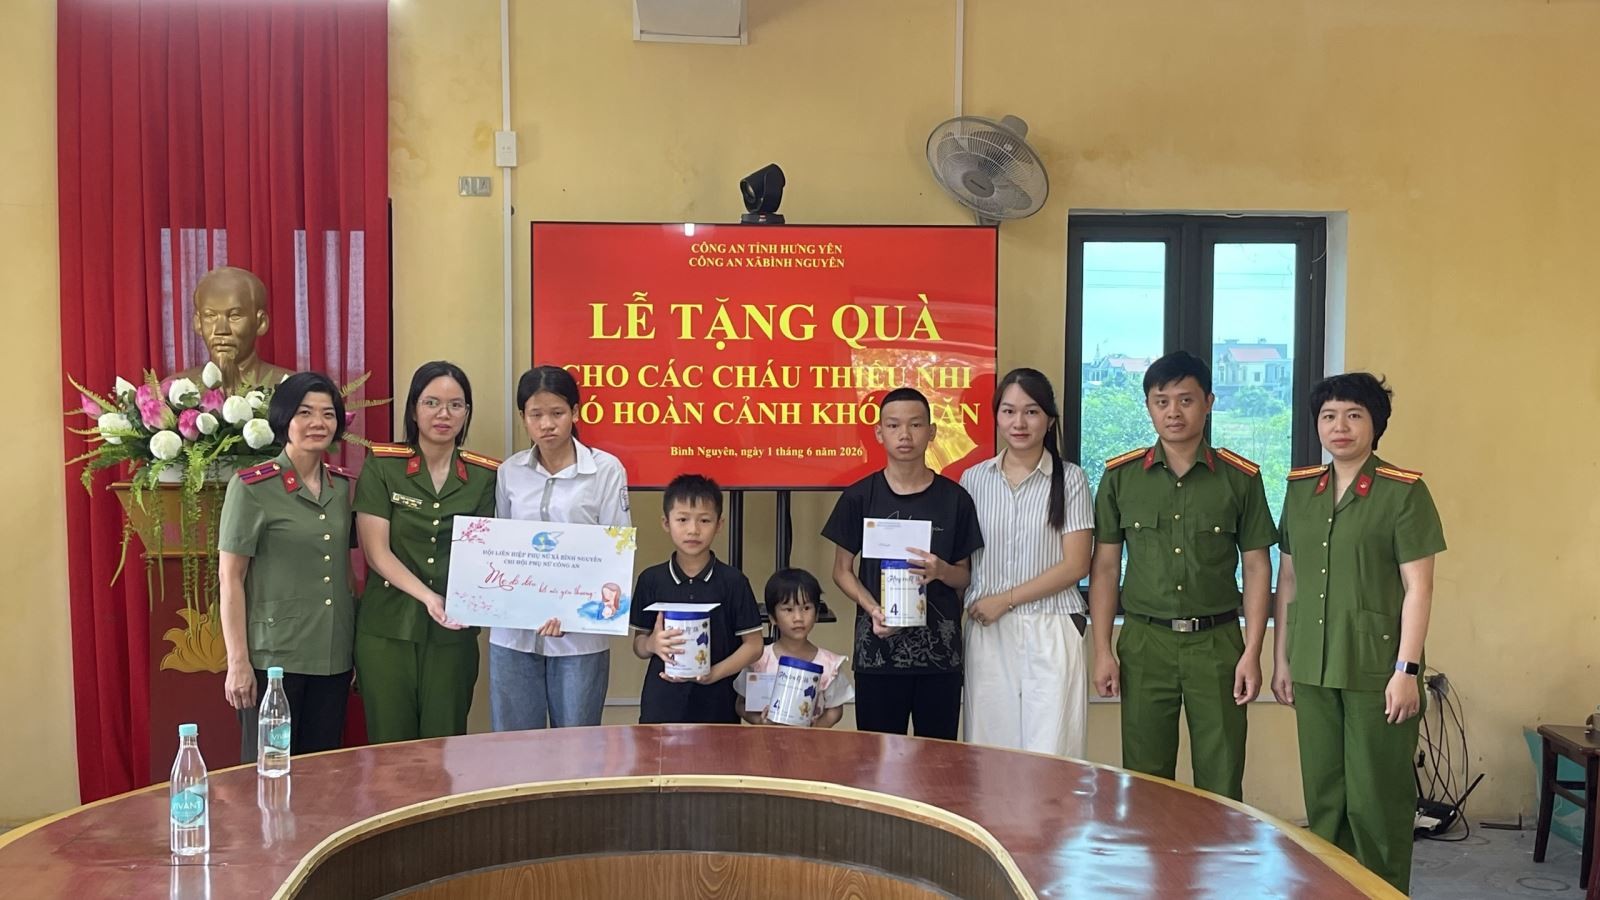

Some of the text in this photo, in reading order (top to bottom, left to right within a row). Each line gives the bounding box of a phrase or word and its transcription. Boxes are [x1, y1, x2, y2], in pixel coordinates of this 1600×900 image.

[691, 241, 726, 254] CÔNG
[728, 243, 745, 254] AN
[780, 243, 816, 255] HƯNG
[818, 242, 843, 255] YÊN
[688, 255, 724, 267] CÔNG
[726, 257, 743, 267] AN
[795, 256, 845, 268] NGUYÊN
[588, 291, 943, 350] LỄ TẶNG QUÀ
[637, 358, 704, 388] CÁC
[712, 358, 802, 388] CHÁU
[810, 359, 908, 389] THIẾU
[917, 366, 973, 389] NHI
[580, 394, 605, 425] Ó
[612, 395, 704, 425] HOÀN
[713, 395, 802, 425] CẢNH
[811, 396, 881, 426] KHÓ
[670, 446, 863, 459] Bình Nguyên, ngày 1 tháng 6 năm 2026
[890, 603, 899, 616] 4
